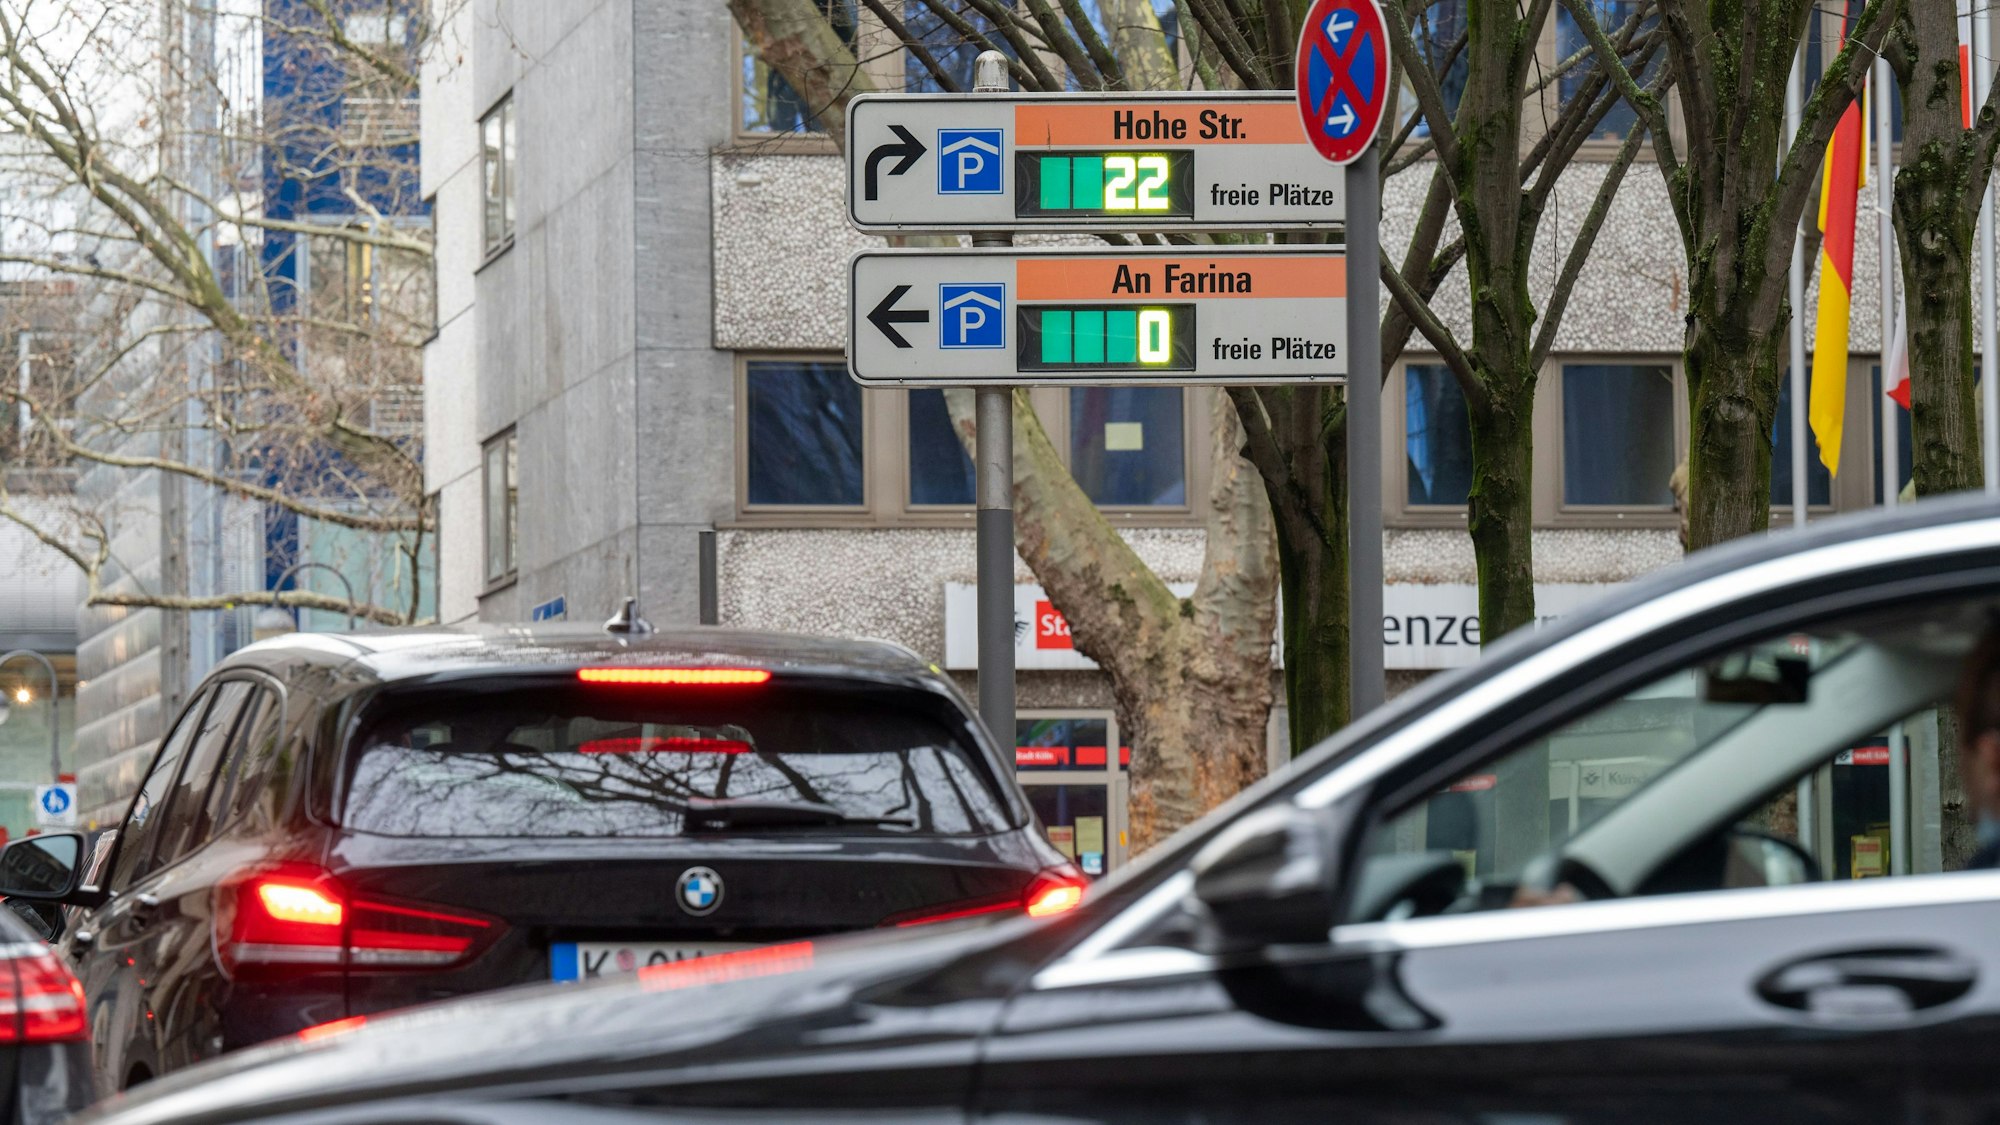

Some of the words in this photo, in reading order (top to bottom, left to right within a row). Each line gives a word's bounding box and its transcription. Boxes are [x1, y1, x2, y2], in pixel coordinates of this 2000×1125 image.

[1114, 110, 1187, 140] Hohe
[1199, 109, 1247, 140] Str.
[958, 152, 985, 189] P
[1104, 156, 1169, 210] 22
[1211, 183, 1260, 206] freie
[1269, 183, 1334, 206] Plätze
[1111, 264, 1151, 294] An
[1164, 263, 1252, 294] Farina
[960, 306, 986, 344] P
[1138, 309, 1171, 364] 0
[1212, 337, 1262, 360] freie
[1271, 337, 1336, 360] Plätze
